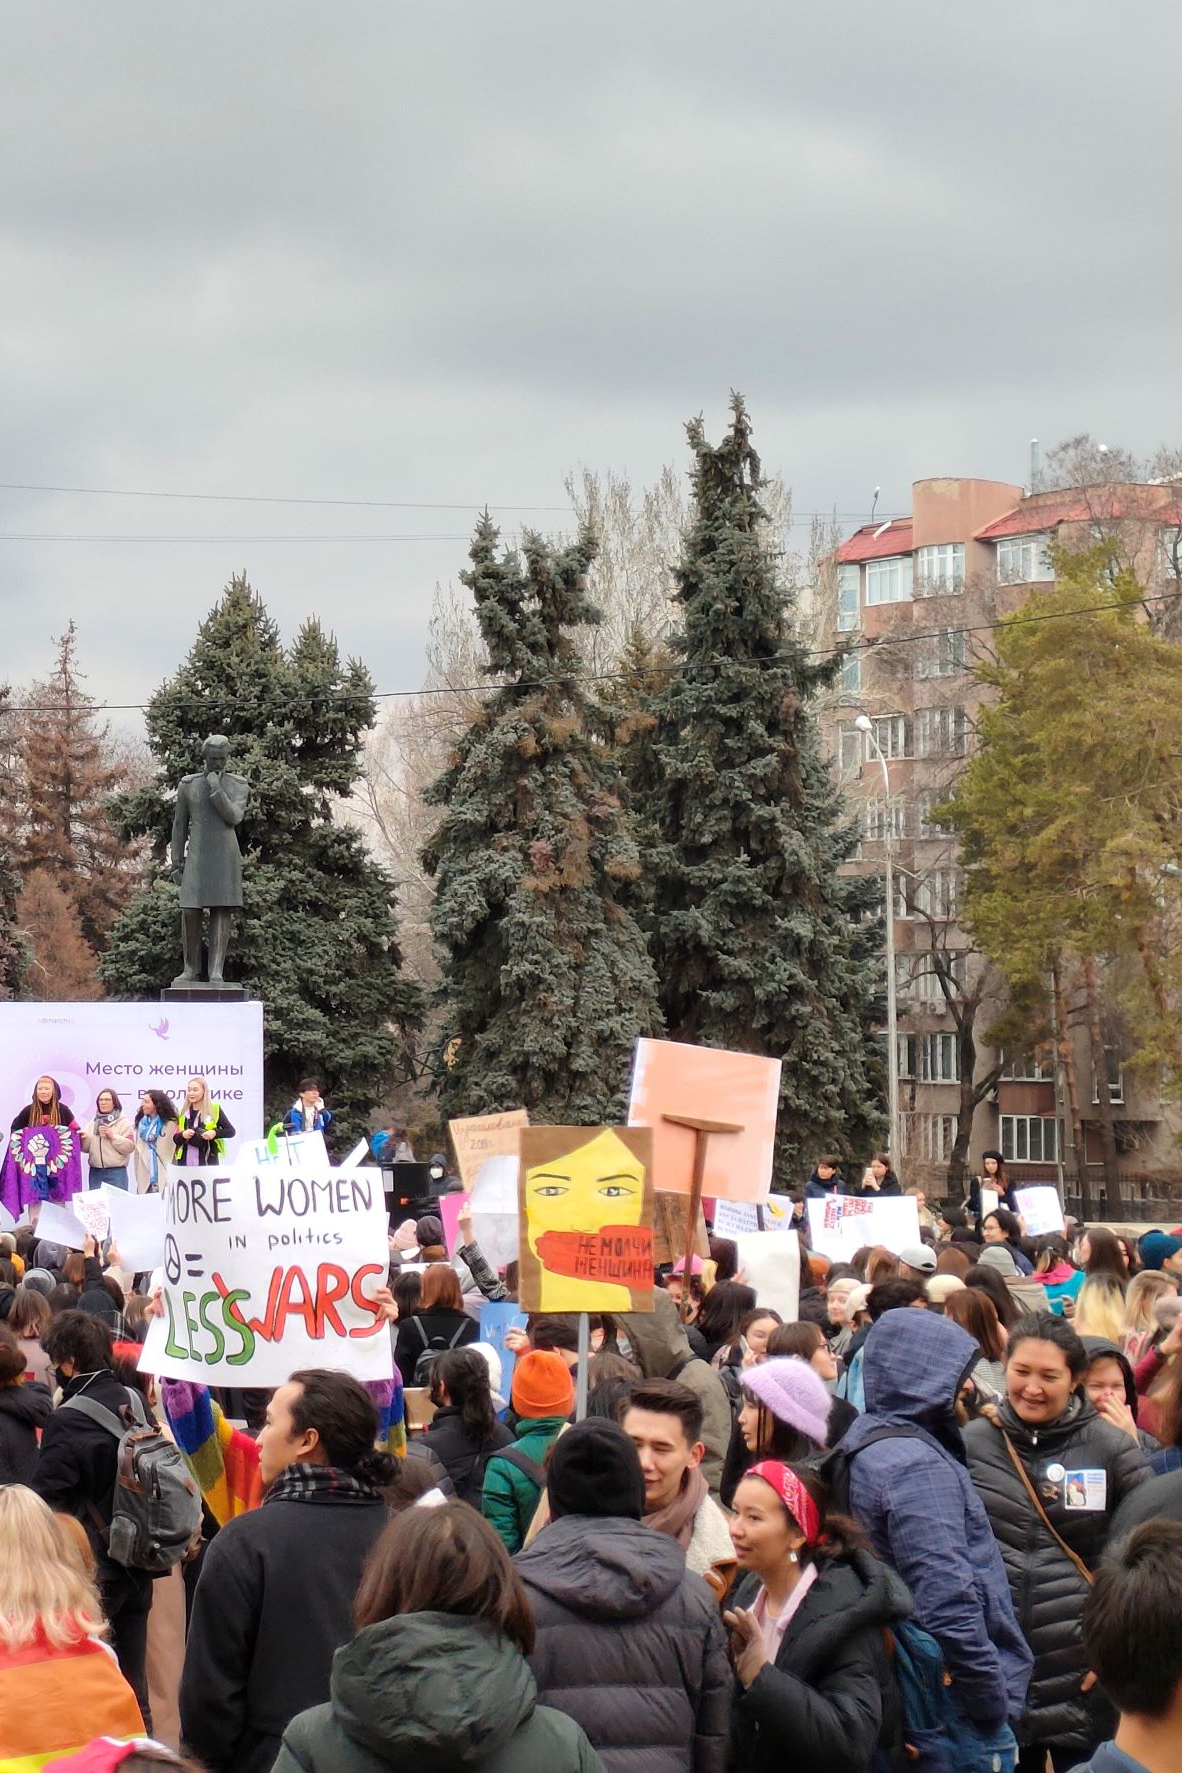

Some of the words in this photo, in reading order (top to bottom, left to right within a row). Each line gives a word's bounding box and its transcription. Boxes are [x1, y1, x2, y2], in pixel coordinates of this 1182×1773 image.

[85, 1062, 143, 1075] Место
[149, 1064, 244, 1077] женщины
[163, 1177, 232, 1225] MORE
[254, 1174, 373, 1217] WOMEN
[228, 1235, 247, 1249] IN
[268, 1227, 344, 1251] politics
[164, 1287, 256, 1367] LESS
[211, 1261, 386, 1344] WARS
